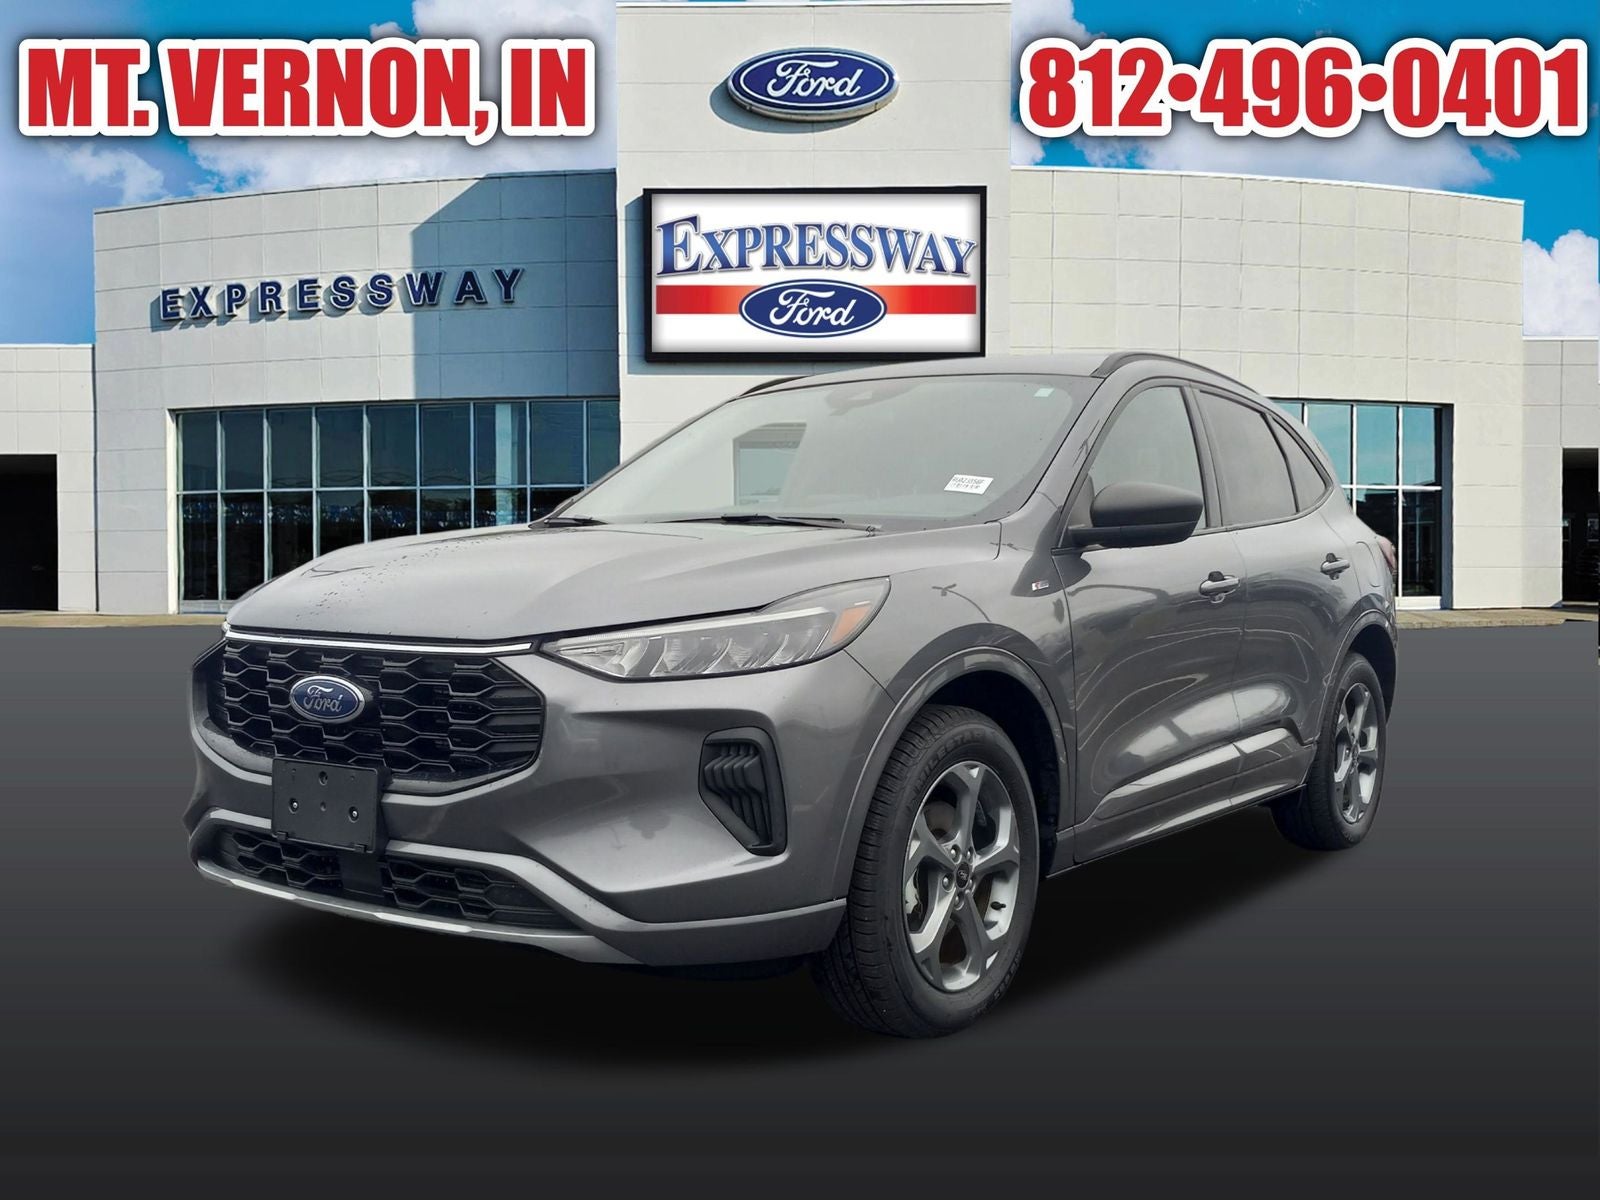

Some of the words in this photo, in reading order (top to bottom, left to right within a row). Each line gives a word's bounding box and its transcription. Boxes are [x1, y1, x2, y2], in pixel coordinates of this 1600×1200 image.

[766, 59, 864, 97] Ford
[160, 268, 525, 320] EXPRESSWAY
[768, 288, 857, 326] Ford
[303, 685, 344, 713] Ford
